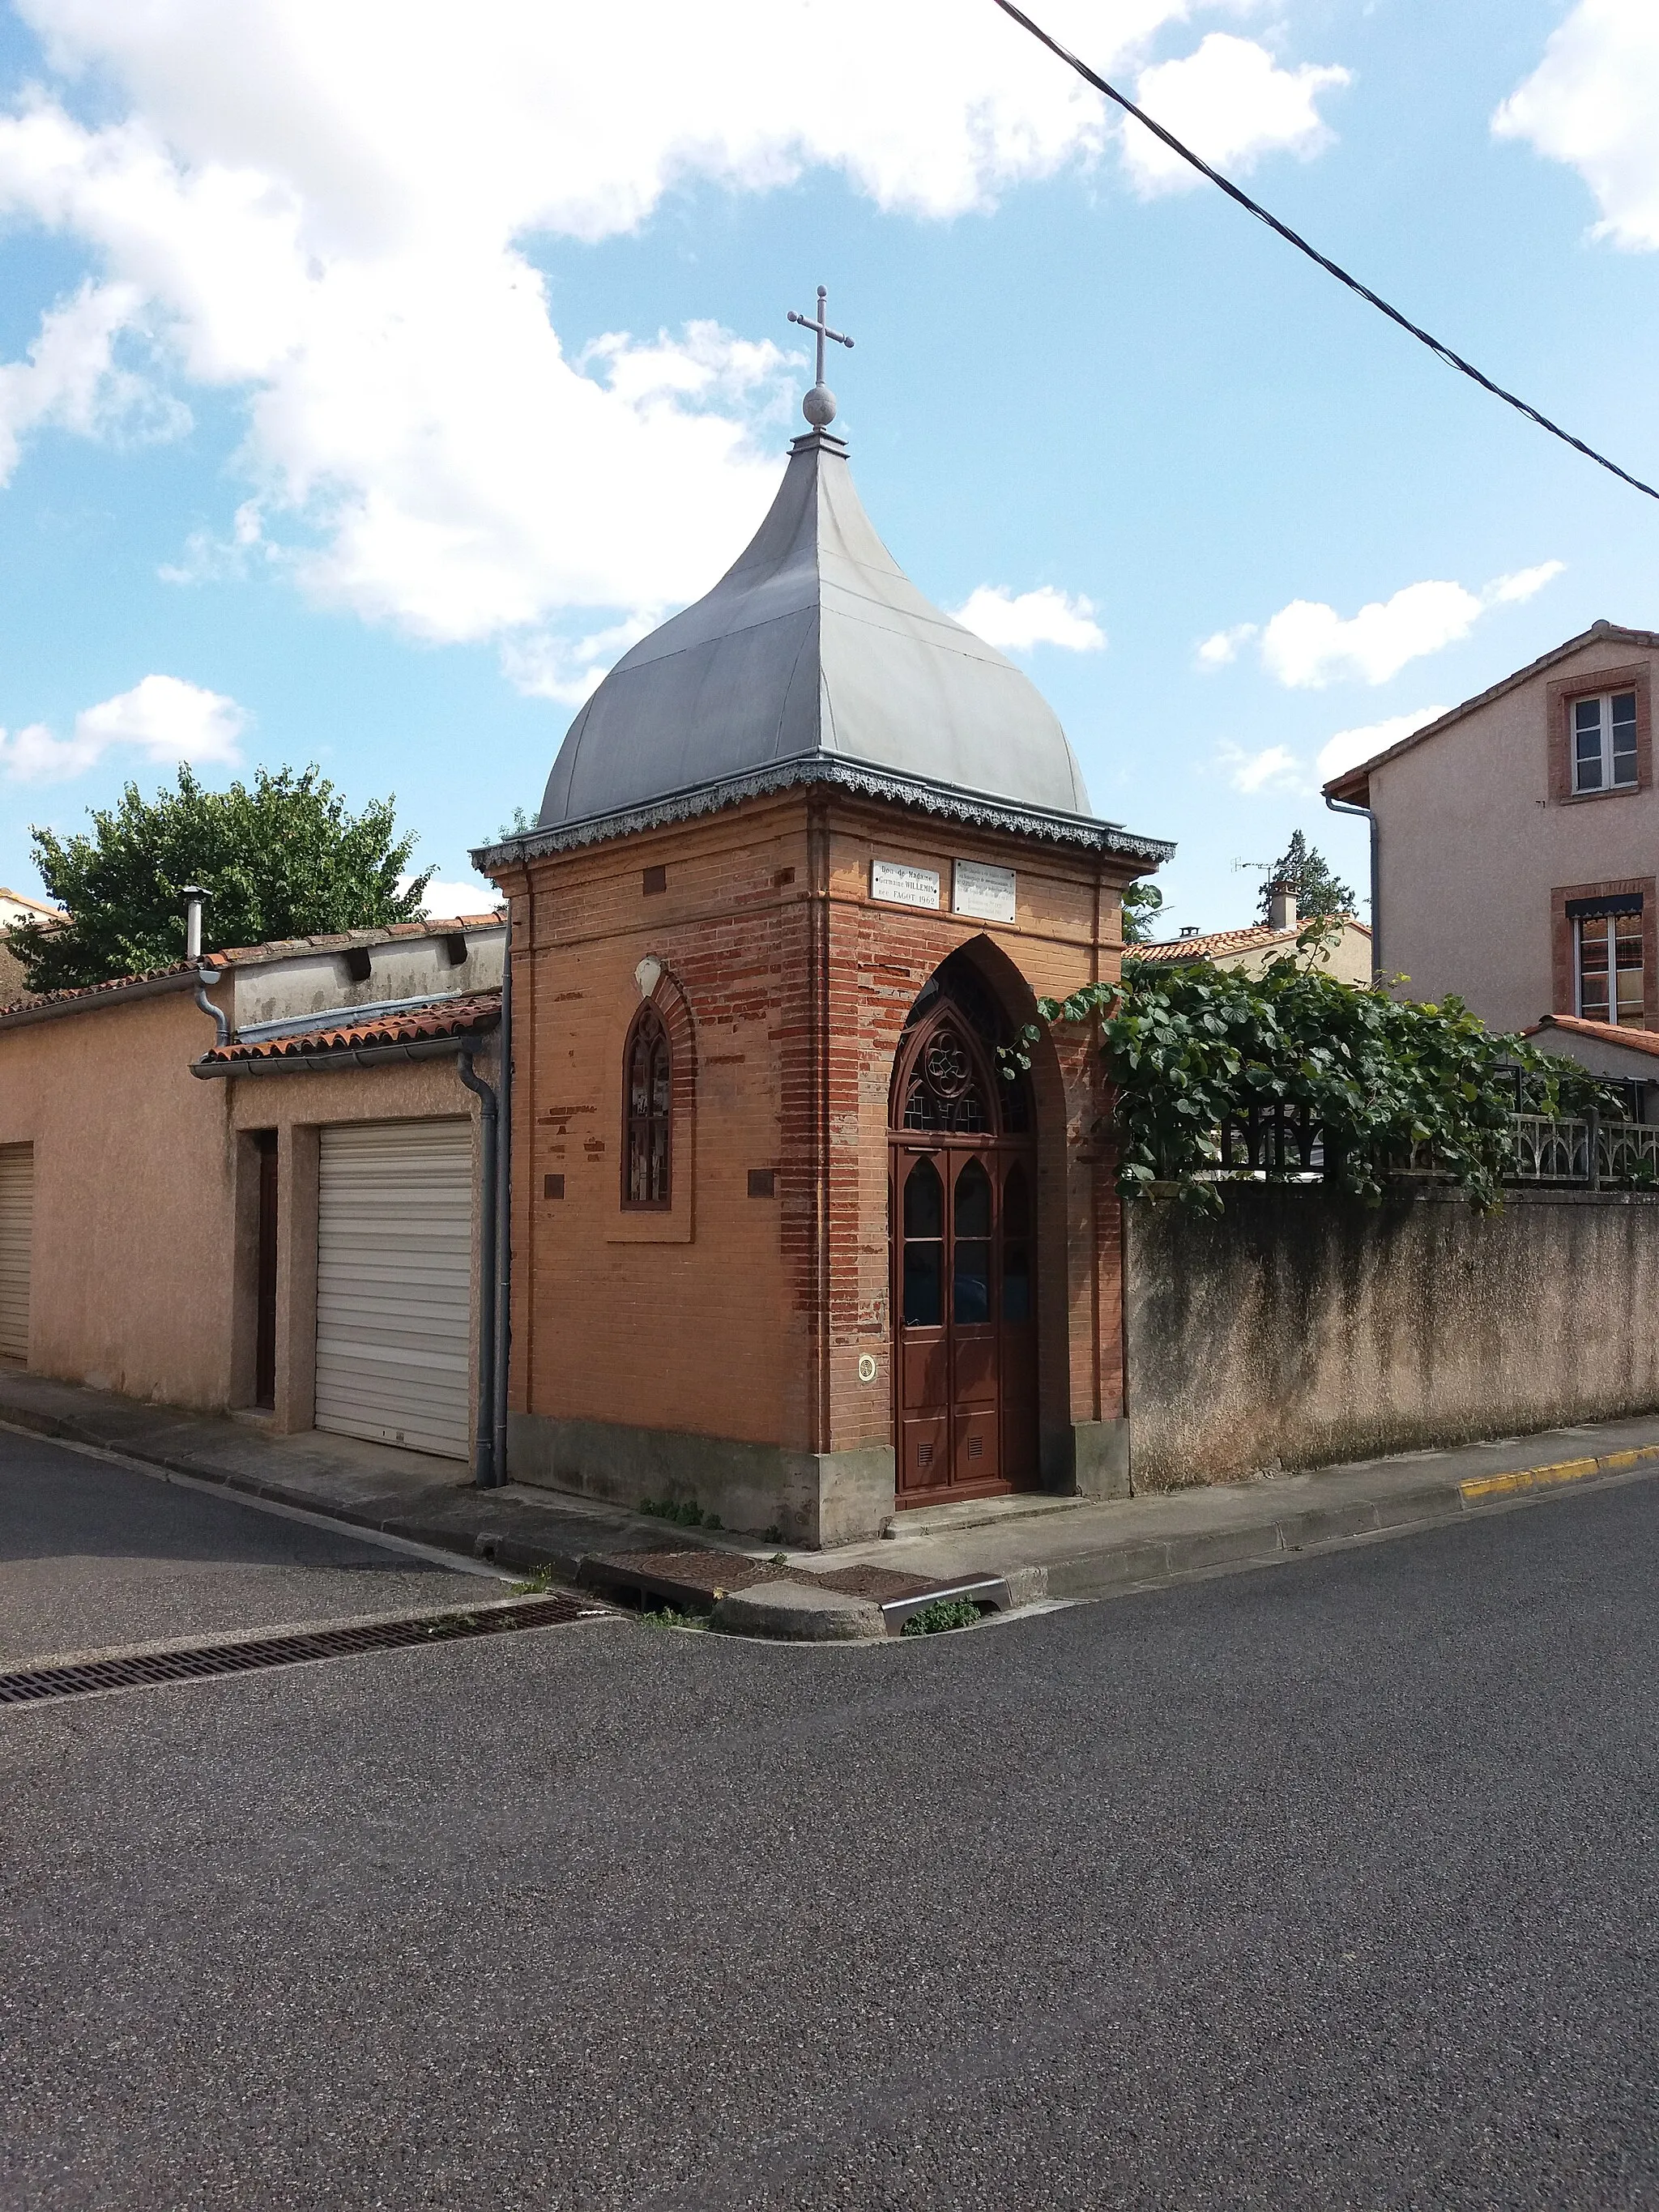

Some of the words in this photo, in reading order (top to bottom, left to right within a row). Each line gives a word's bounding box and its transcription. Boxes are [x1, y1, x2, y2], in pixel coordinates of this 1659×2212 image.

[881, 866, 893, 874] Don
[908, 871, 932, 881] Madame
[879, 876, 904, 888] Germaine
[905, 881, 934, 893] WILLEMIN
[893, 891, 915, 901] FAGOT
[919, 895, 935, 905] 1962
